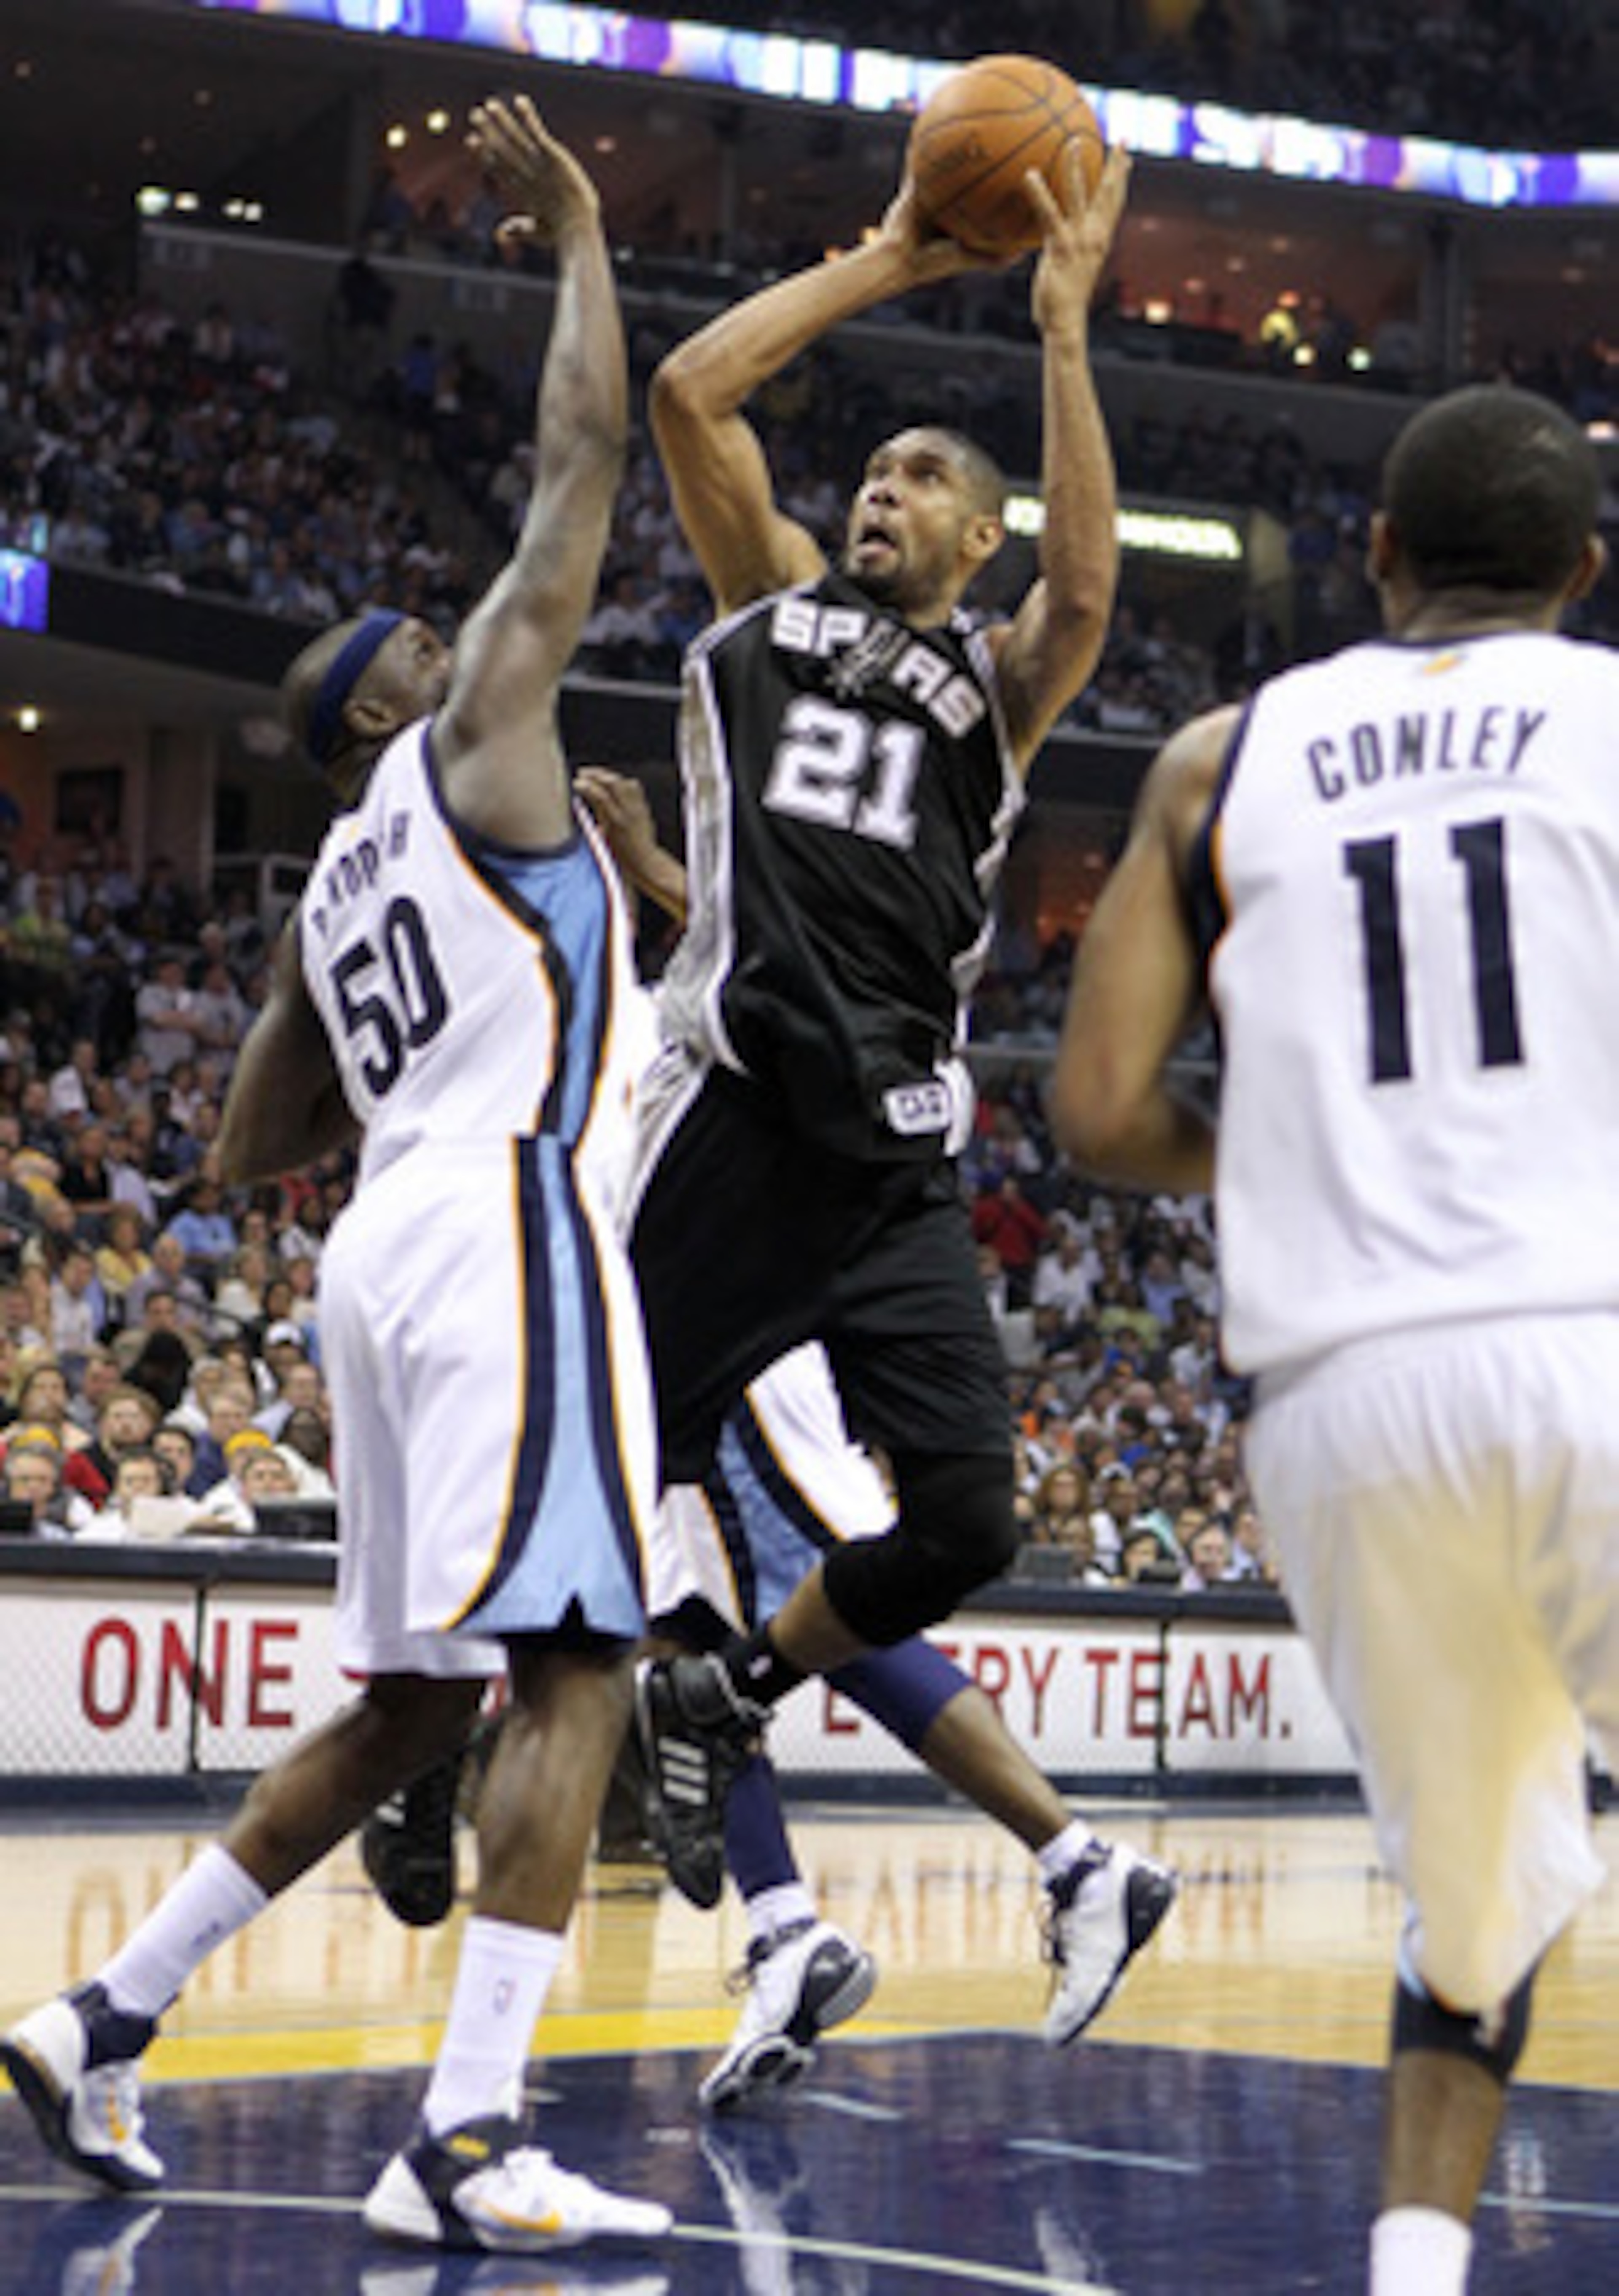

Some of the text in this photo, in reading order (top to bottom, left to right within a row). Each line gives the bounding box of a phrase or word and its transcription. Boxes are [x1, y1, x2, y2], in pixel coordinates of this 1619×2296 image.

[761, 691, 926, 851] 21
[1307, 705, 1546, 802] CONLEY
[329, 895, 449, 1100] 50
[1342, 816, 1525, 1083] 11
[81, 1617, 298, 1732] ONE
[1084, 1648, 1292, 1740] TEAM.
